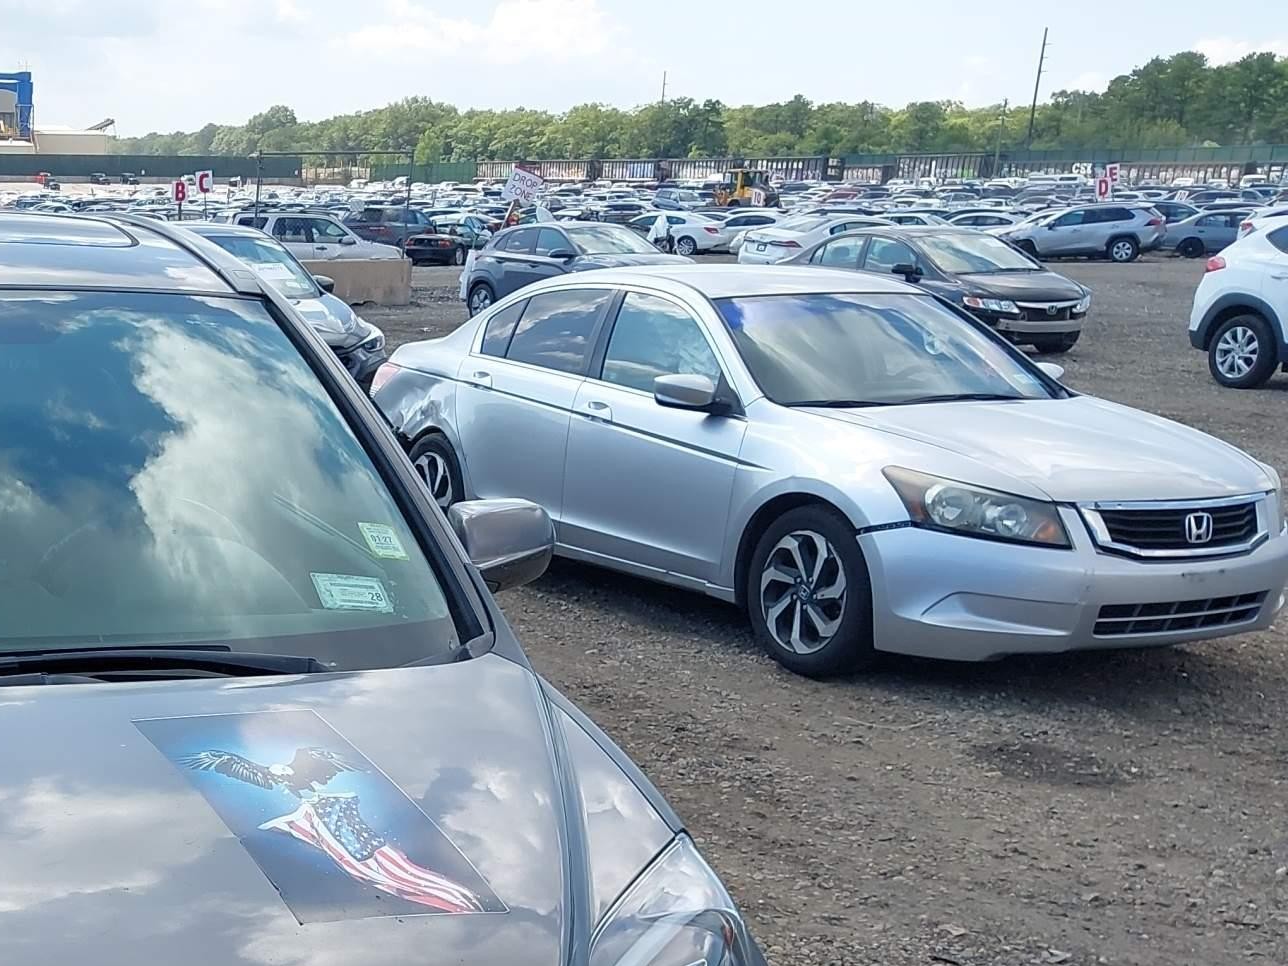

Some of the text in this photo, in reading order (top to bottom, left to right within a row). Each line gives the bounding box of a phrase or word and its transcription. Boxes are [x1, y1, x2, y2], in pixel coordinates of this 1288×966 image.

[512, 172, 538, 190] DROP
[1109, 166, 1118, 181] E
[175, 182, 186, 201] B
[199, 173, 210, 193] C
[1098, 179, 1109, 197] D
[510, 184, 533, 202] ZONE
